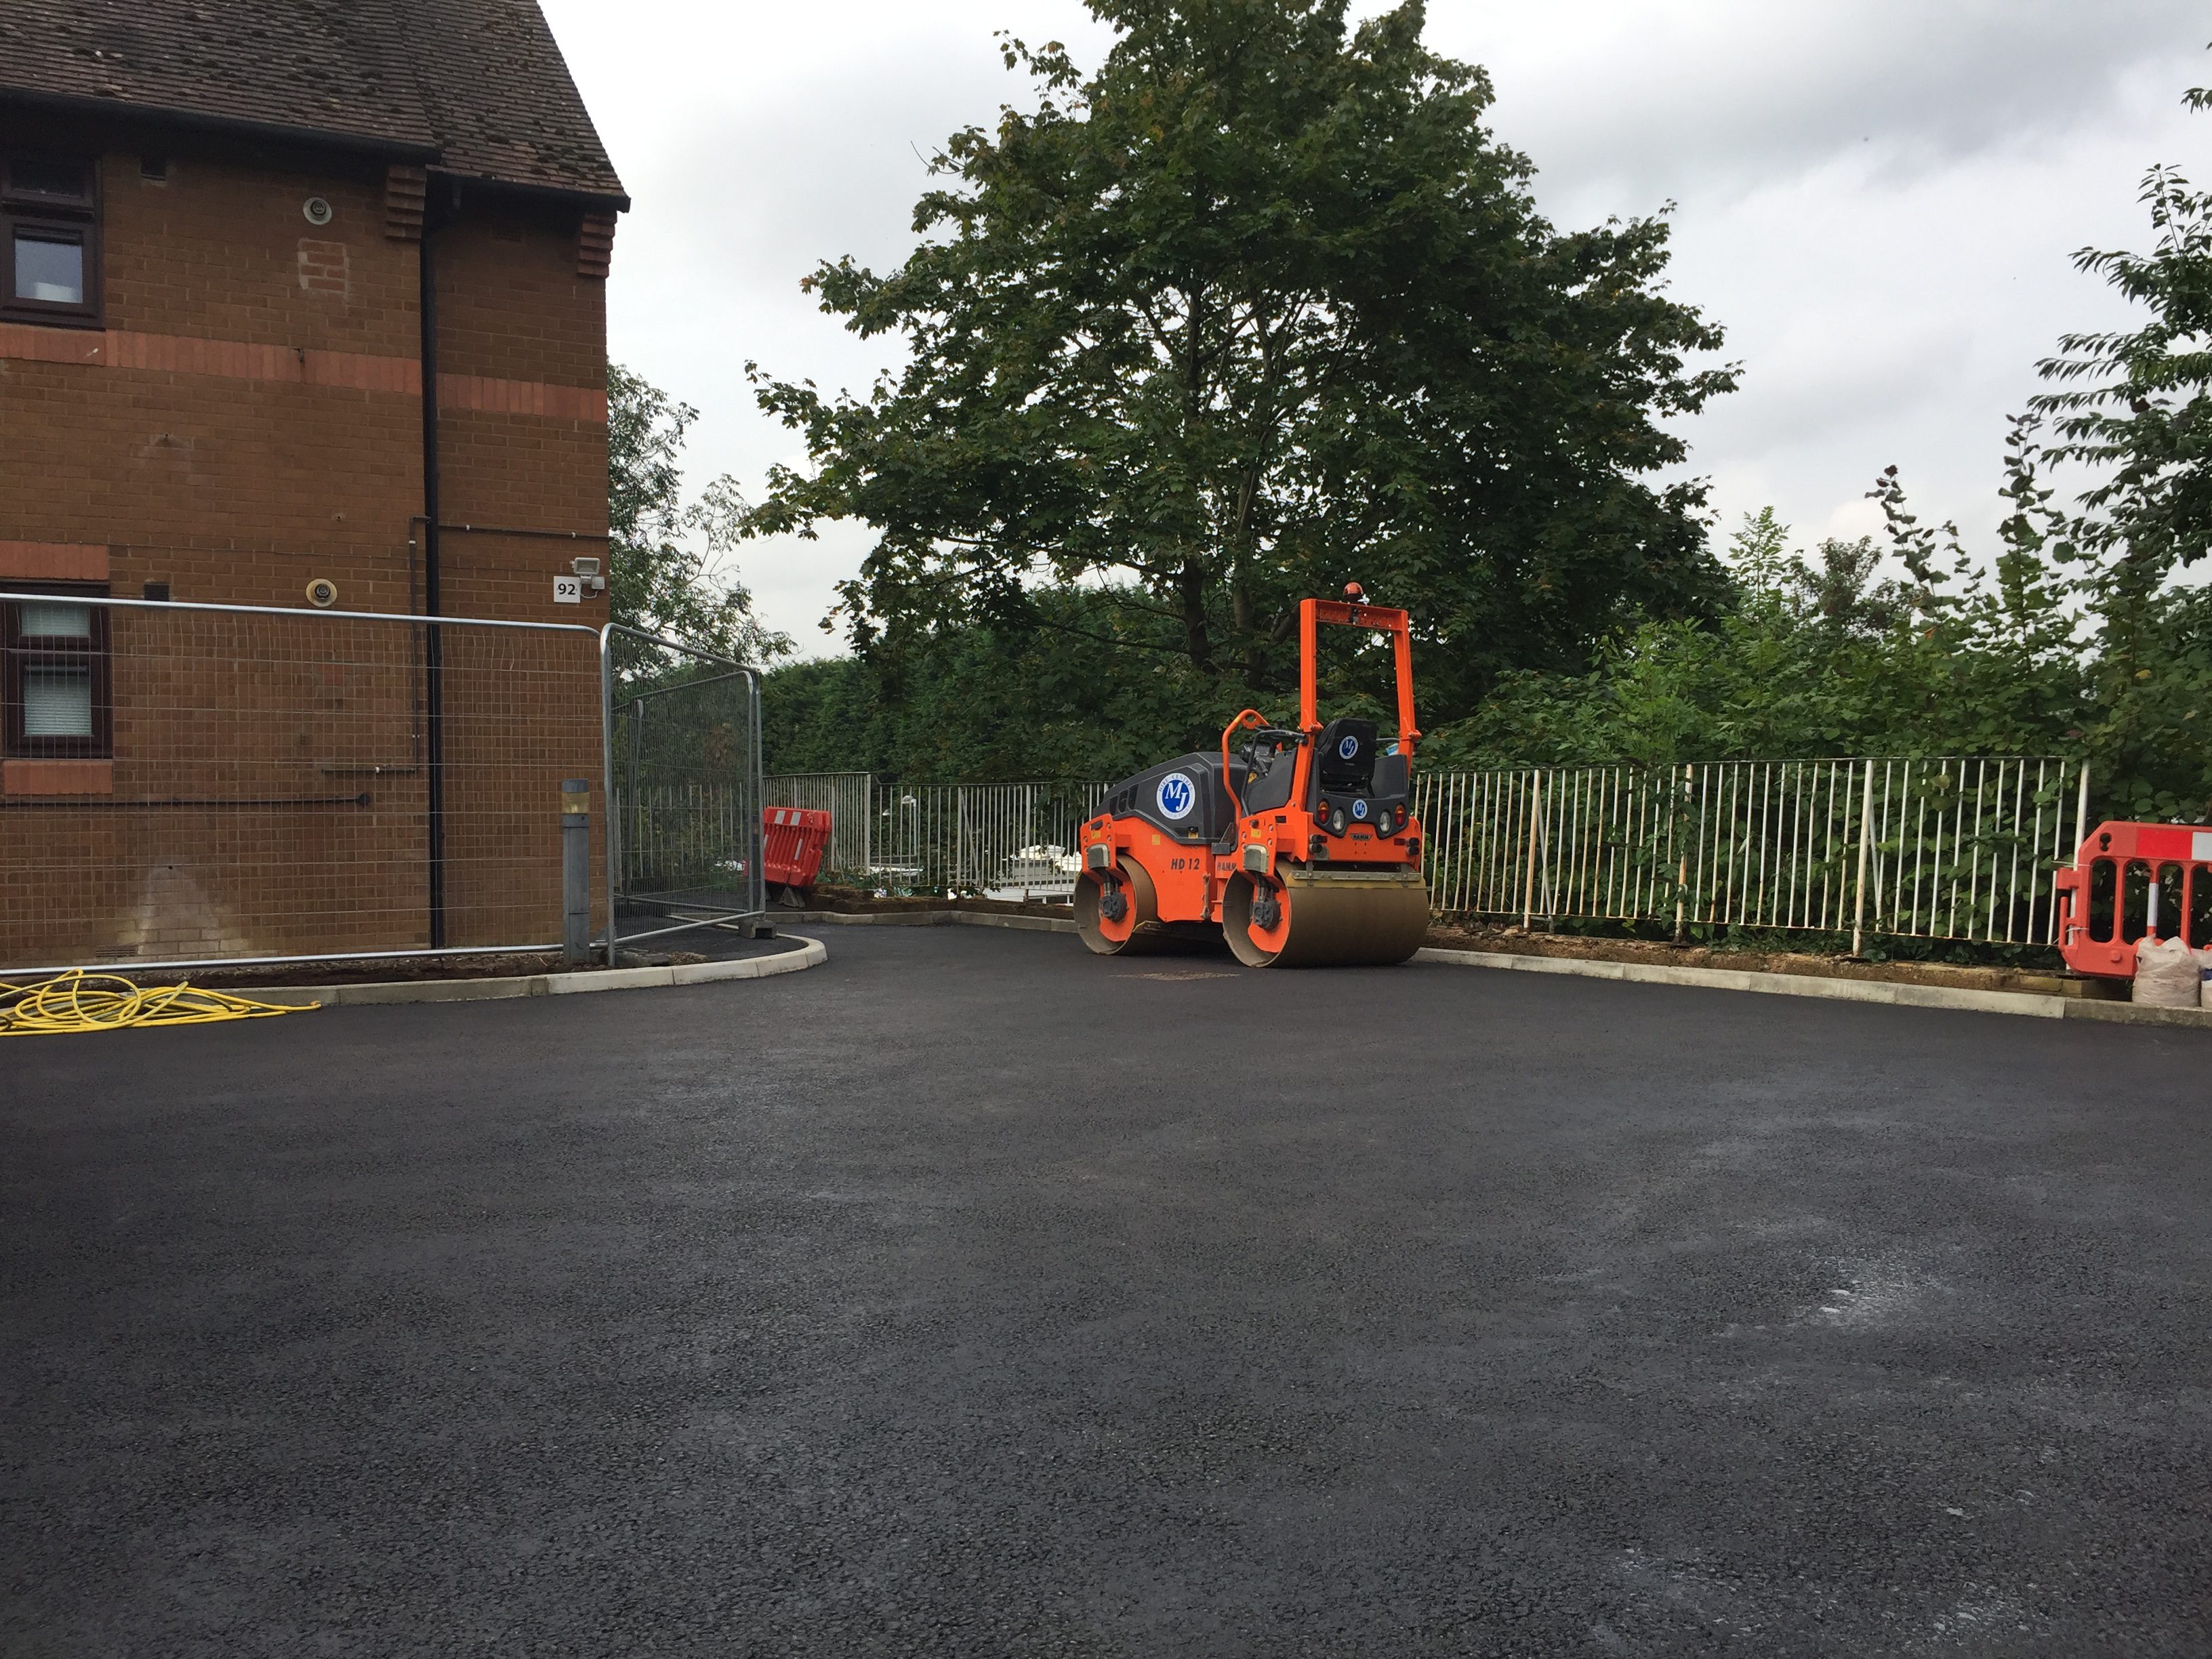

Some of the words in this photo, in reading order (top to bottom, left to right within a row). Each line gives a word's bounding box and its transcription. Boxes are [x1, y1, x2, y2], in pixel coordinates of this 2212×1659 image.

[558, 583, 576, 595] 92
[1343, 740, 1354, 755] MJ
[1164, 781, 1189, 812] MJ
[1171, 858, 1185, 870] HD
[1189, 858, 1200, 870] 12
